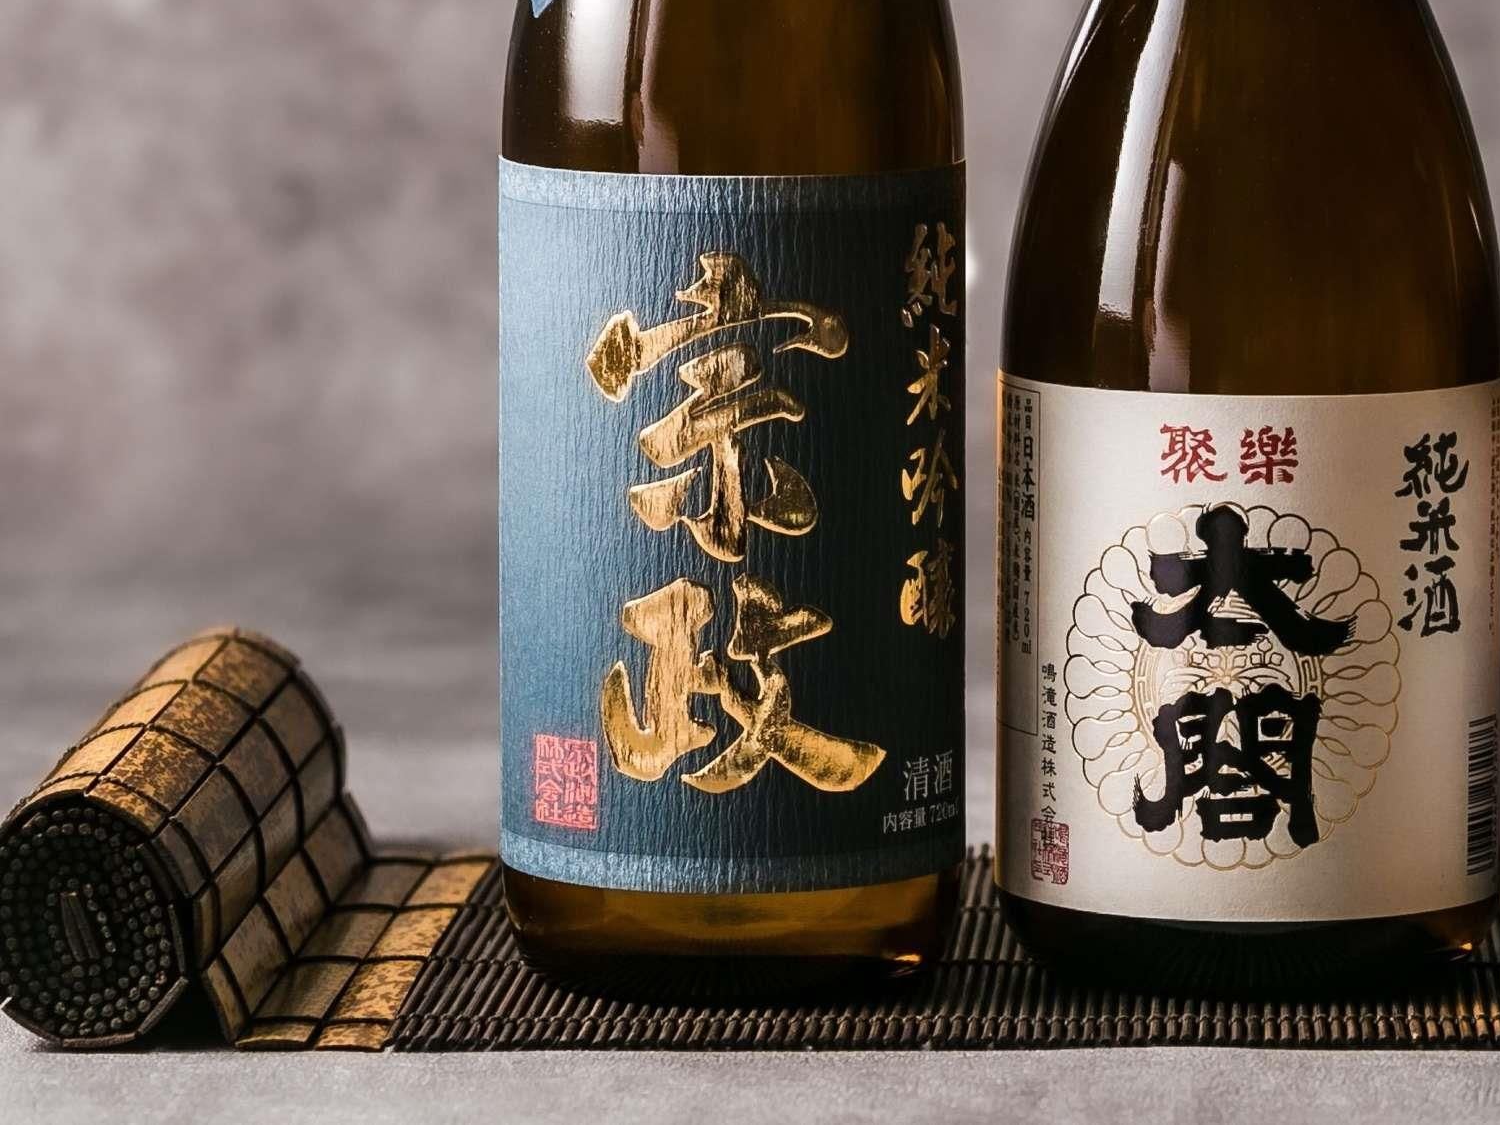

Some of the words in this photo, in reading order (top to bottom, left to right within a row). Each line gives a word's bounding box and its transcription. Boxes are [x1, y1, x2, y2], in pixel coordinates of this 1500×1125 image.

[585, 251, 887, 793] 宗政
[1019, 434, 1036, 522] 日本酒
[1395, 431, 1469, 638] 純米酒
[903, 750, 952, 800] 清酒
